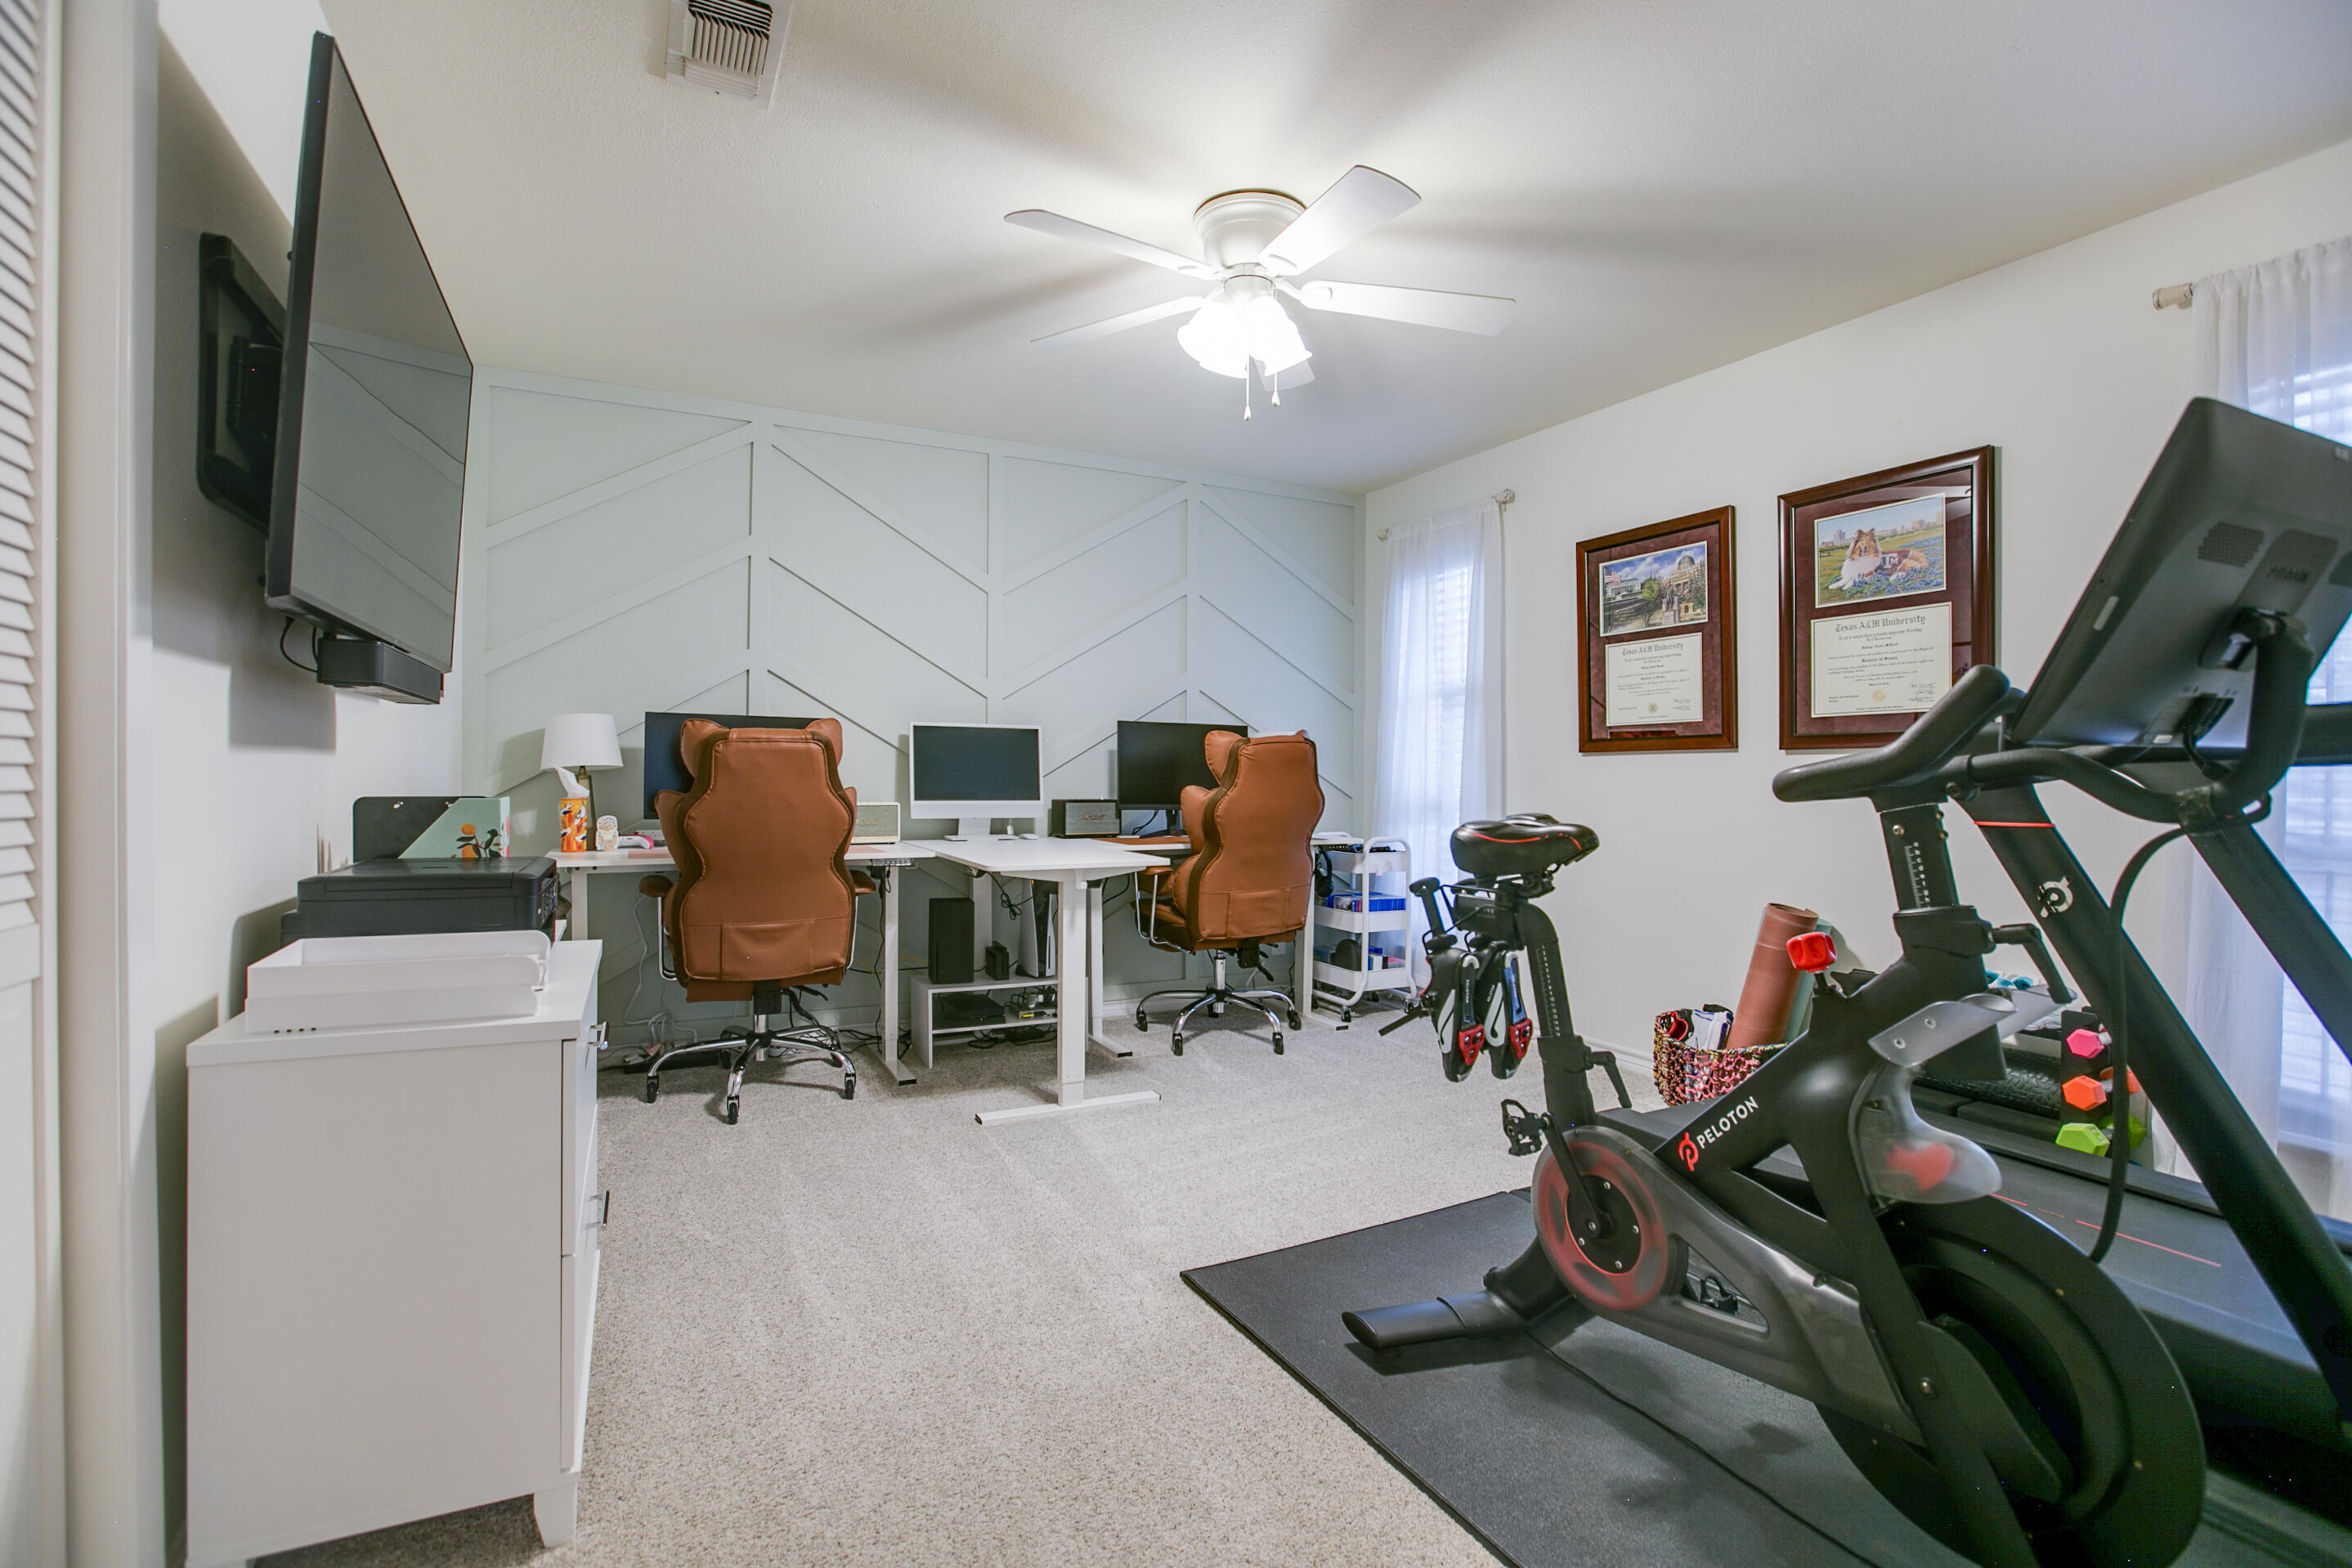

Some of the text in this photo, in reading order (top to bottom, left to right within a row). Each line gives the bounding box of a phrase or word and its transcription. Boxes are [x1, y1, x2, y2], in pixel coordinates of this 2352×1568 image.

[1835, 615, 1926, 633] Texas A&M University
[1654, 643, 1684, 652] University
[1696, 1095, 1759, 1149] PELOTON
